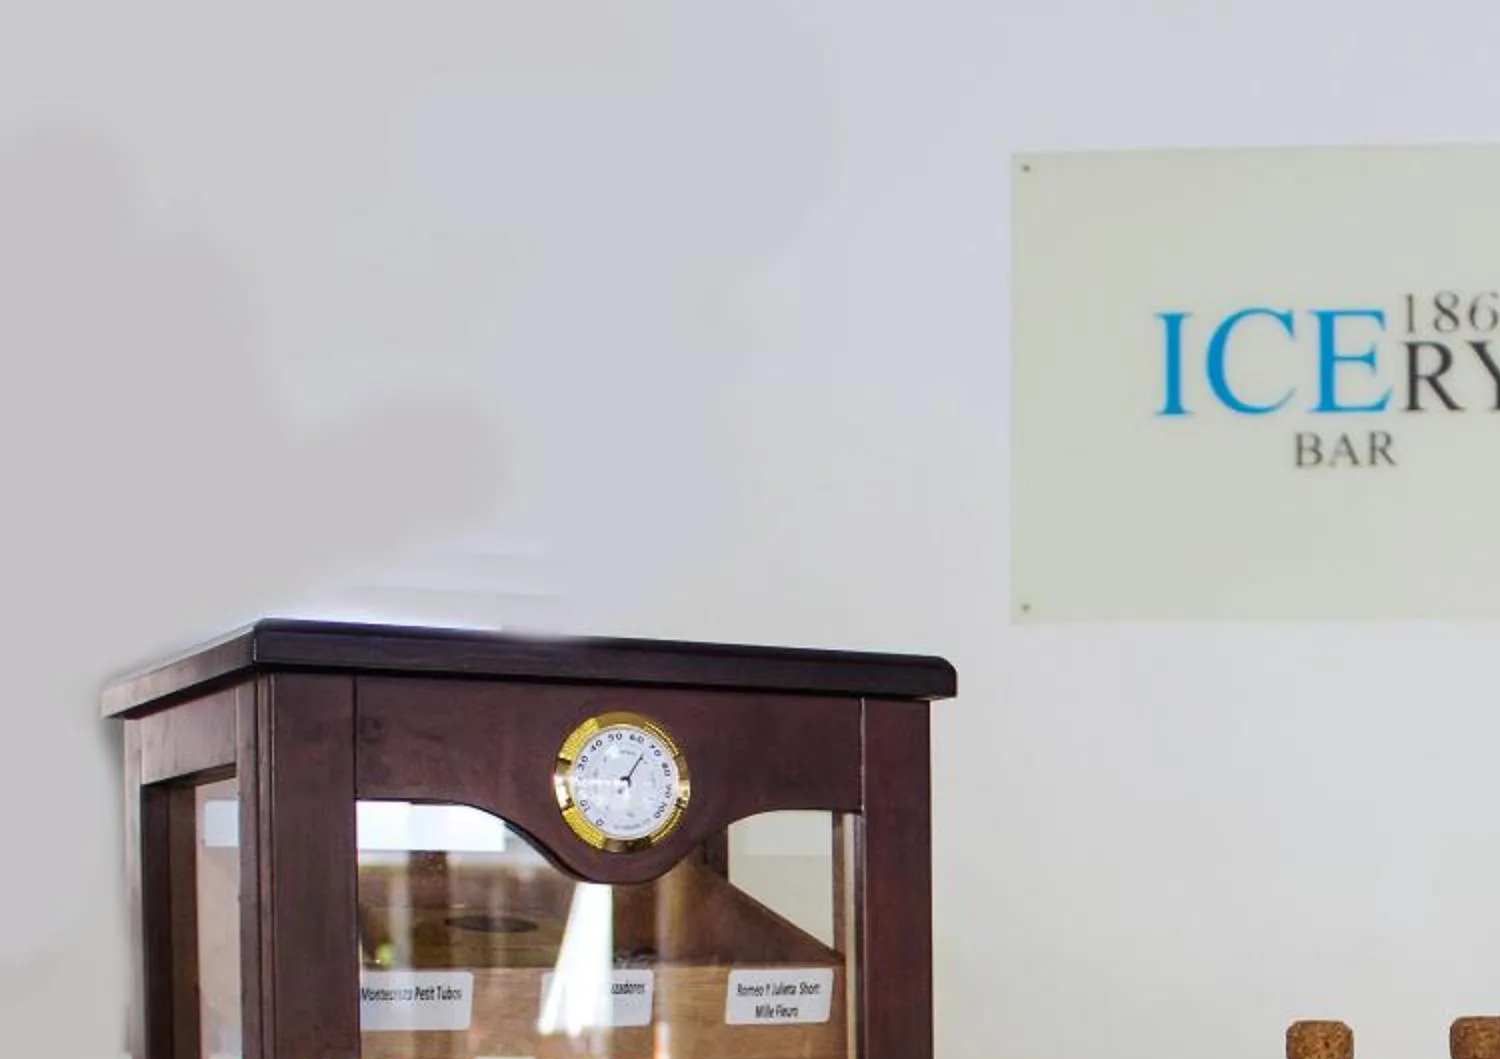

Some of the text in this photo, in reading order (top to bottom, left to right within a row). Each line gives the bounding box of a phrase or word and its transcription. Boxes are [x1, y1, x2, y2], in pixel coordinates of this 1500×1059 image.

[1294, 430, 1397, 468] BAR
[415, 985, 435, 1001] Petit
[437, 984, 462, 1001] Tubos
[737, 982, 764, 996] Romeo
